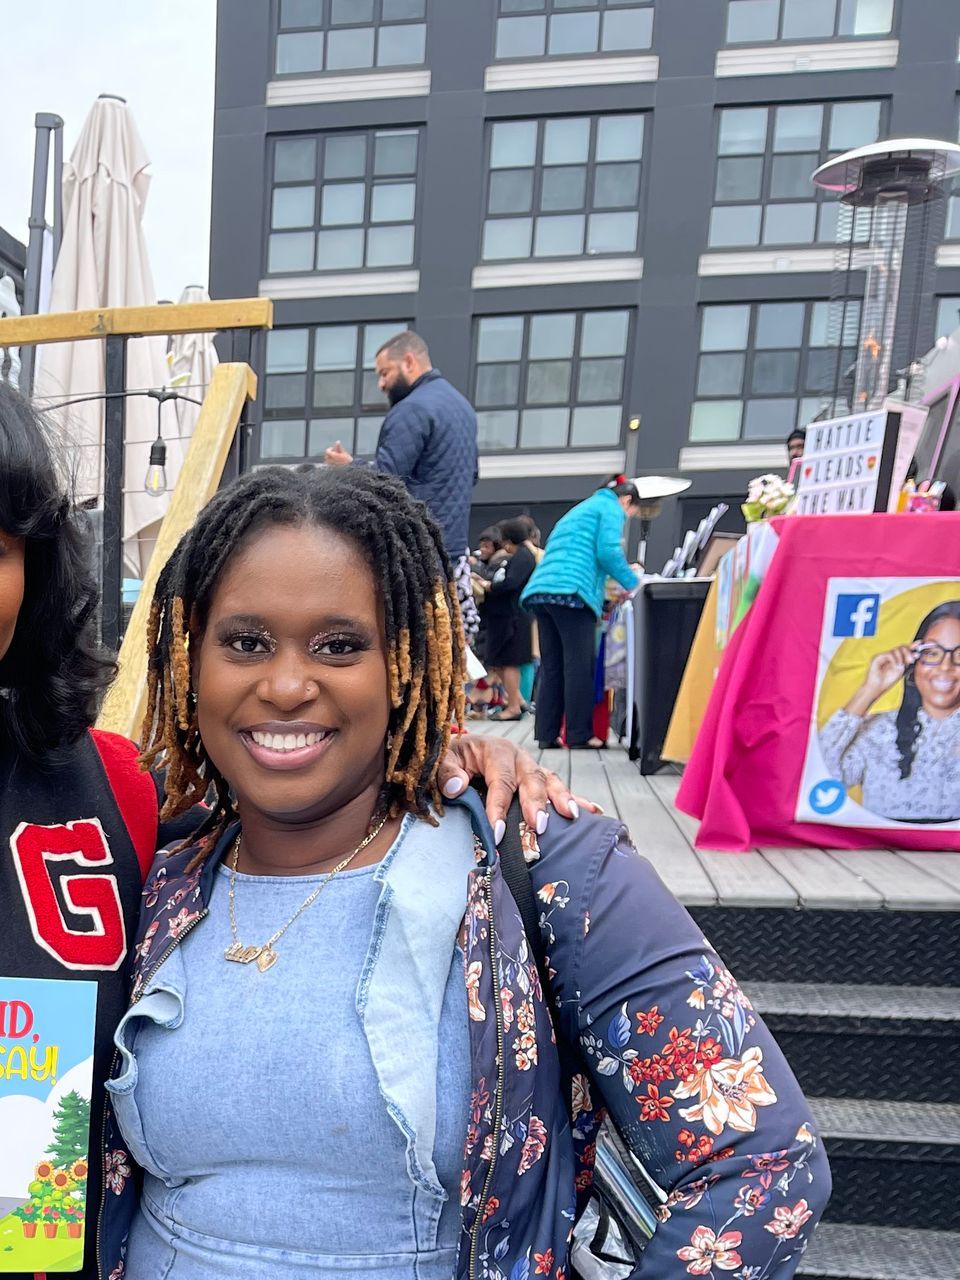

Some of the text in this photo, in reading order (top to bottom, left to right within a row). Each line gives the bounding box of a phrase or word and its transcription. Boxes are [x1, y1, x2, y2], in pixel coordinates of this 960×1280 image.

[813, 419, 874, 450] HATTIE
[814, 454, 865, 483] LEADS
[800, 486, 868, 513] THE WAY
[9, 817, 128, 971] G
